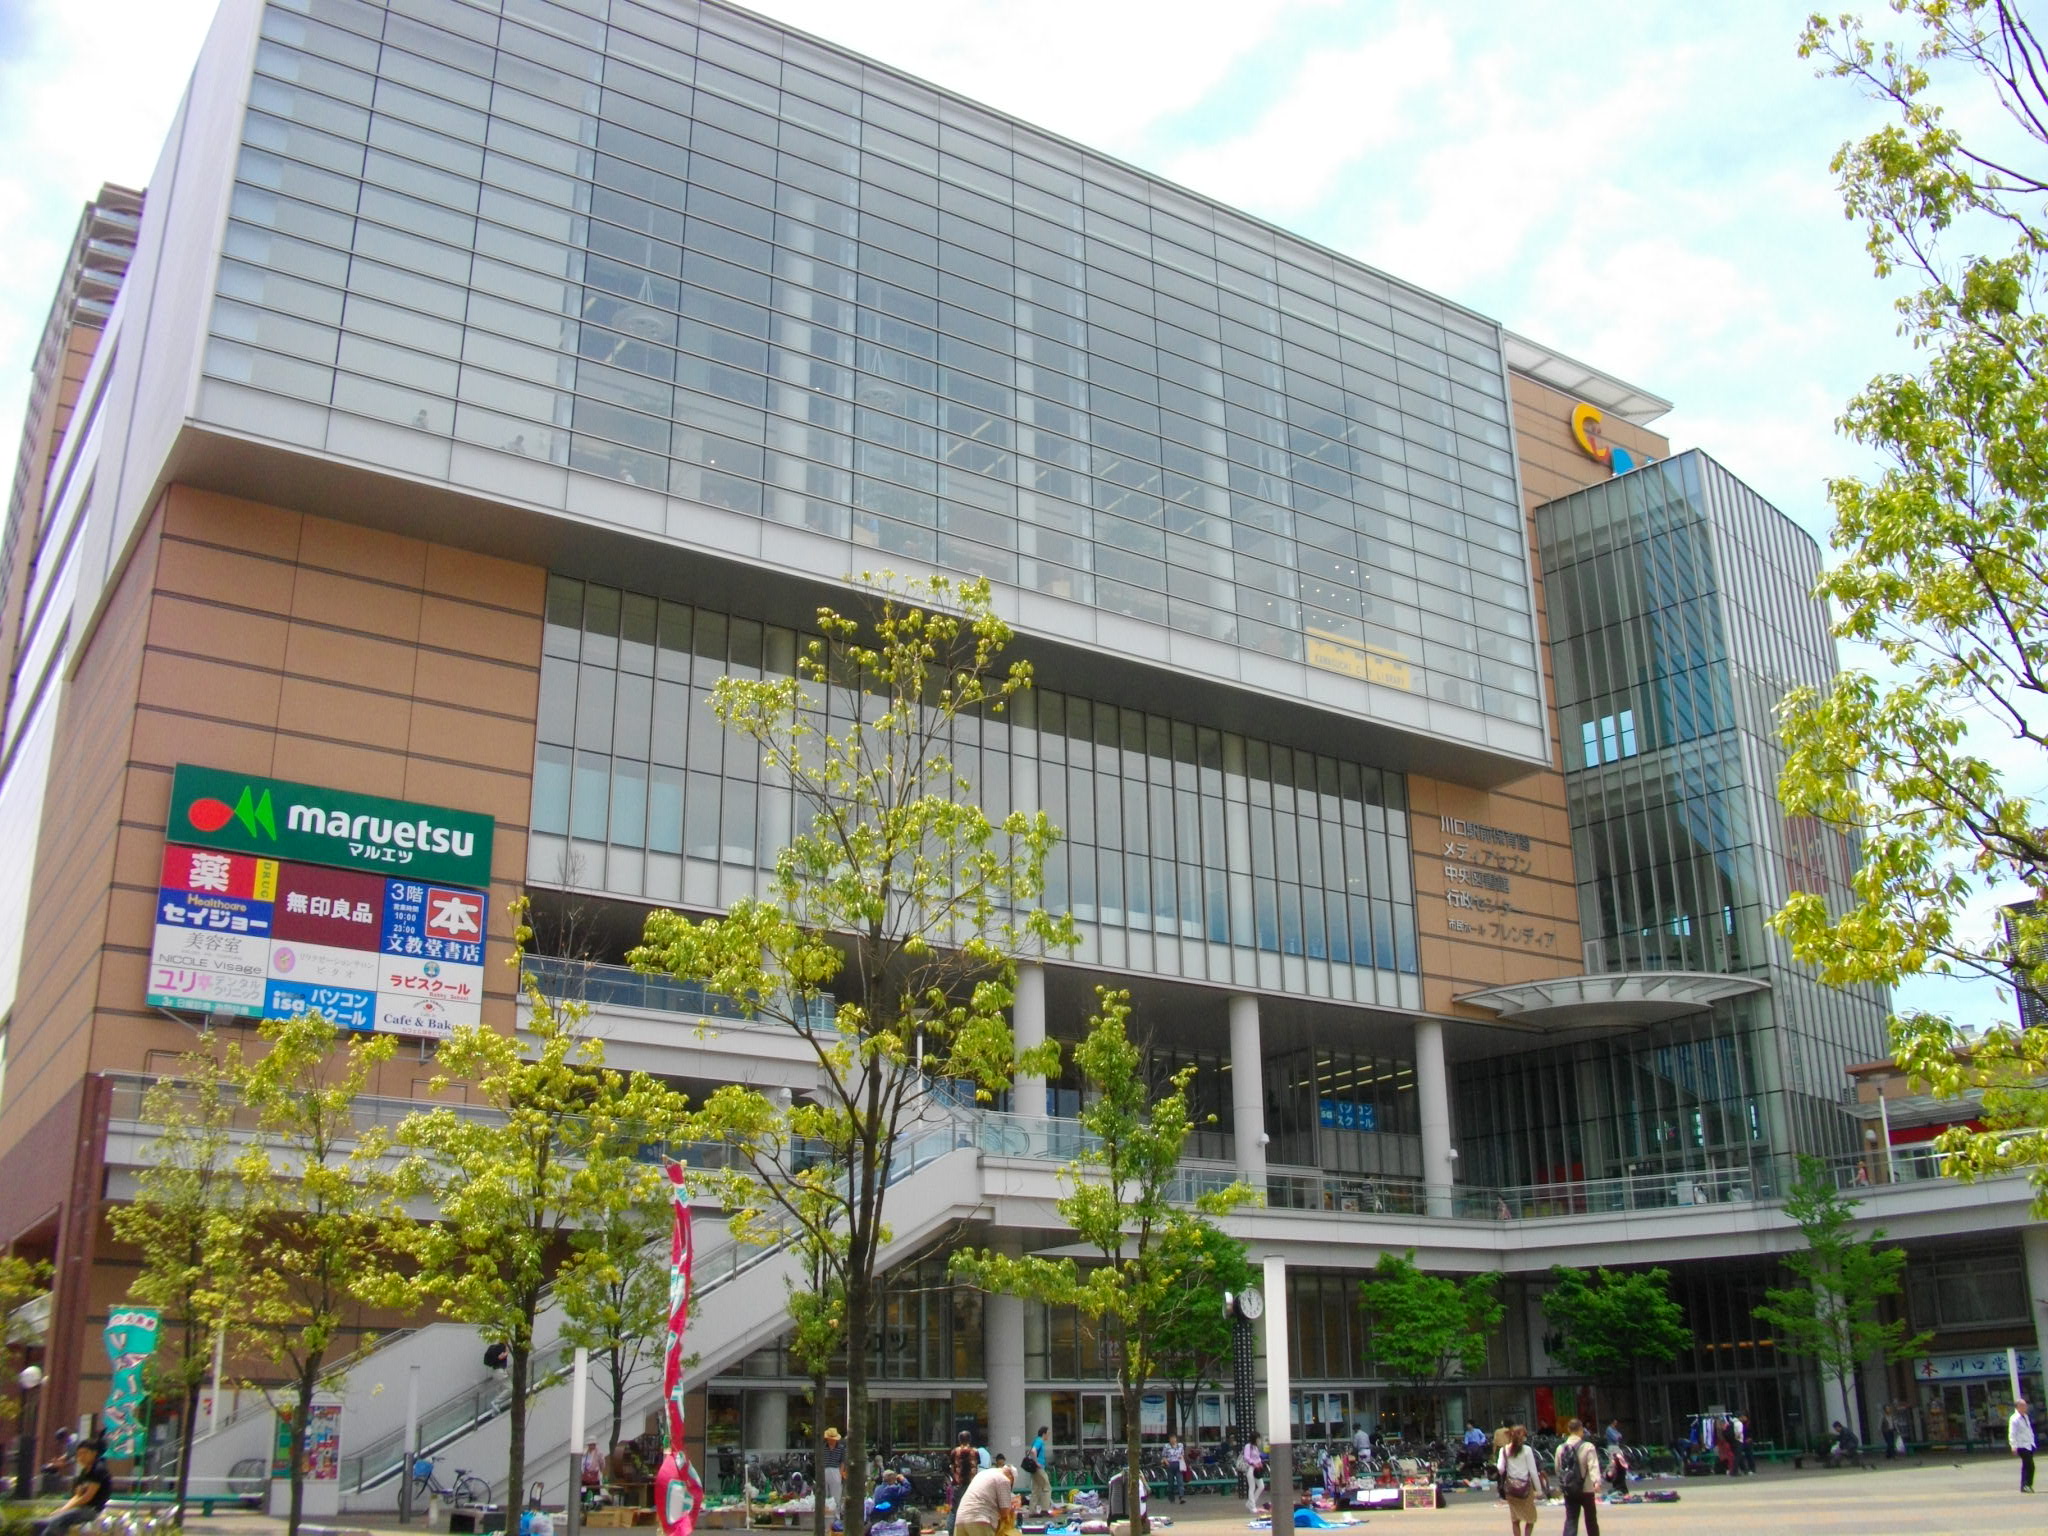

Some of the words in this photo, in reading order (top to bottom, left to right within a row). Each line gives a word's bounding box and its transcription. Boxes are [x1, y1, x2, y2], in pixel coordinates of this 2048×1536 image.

[288, 805, 474, 857] maruetsu
[1441, 815, 1531, 852] 川口駅前保育園
[349, 842, 413, 864] マルエツ
[1443, 841, 1532, 875] メディアセブン
[189, 853, 231, 892] 薬
[260, 862, 272, 898] DRUG
[1444, 864, 1510, 894] 中央図書館
[187, 893, 247, 912] Healthcare
[391, 883, 423, 903] 3階
[1446, 887, 1524, 918] 行政センター
[163, 903, 268, 931] セイジョー
[286, 891, 373, 923] 無印良品
[394, 912, 416, 922] 10:00
[430, 897, 478, 935] 本
[393, 924, 415, 934] 23:00
[184, 932, 242, 953] 美容室
[386, 934, 480, 962] 文教堂書店
[159, 953, 208, 968] NICOLE
[213, 960, 262, 975] Visage
[154, 969, 197, 993] ユリ
[215, 975, 260, 989] デンタル
[390, 974, 471, 996] ラビスクール
[215, 986, 260, 1000] クリニック
[273, 990, 305, 1012] isa
[311, 989, 369, 1009] パソコン
[383, 1013, 412, 1026] Café
[414, 1016, 424, 1027] &
